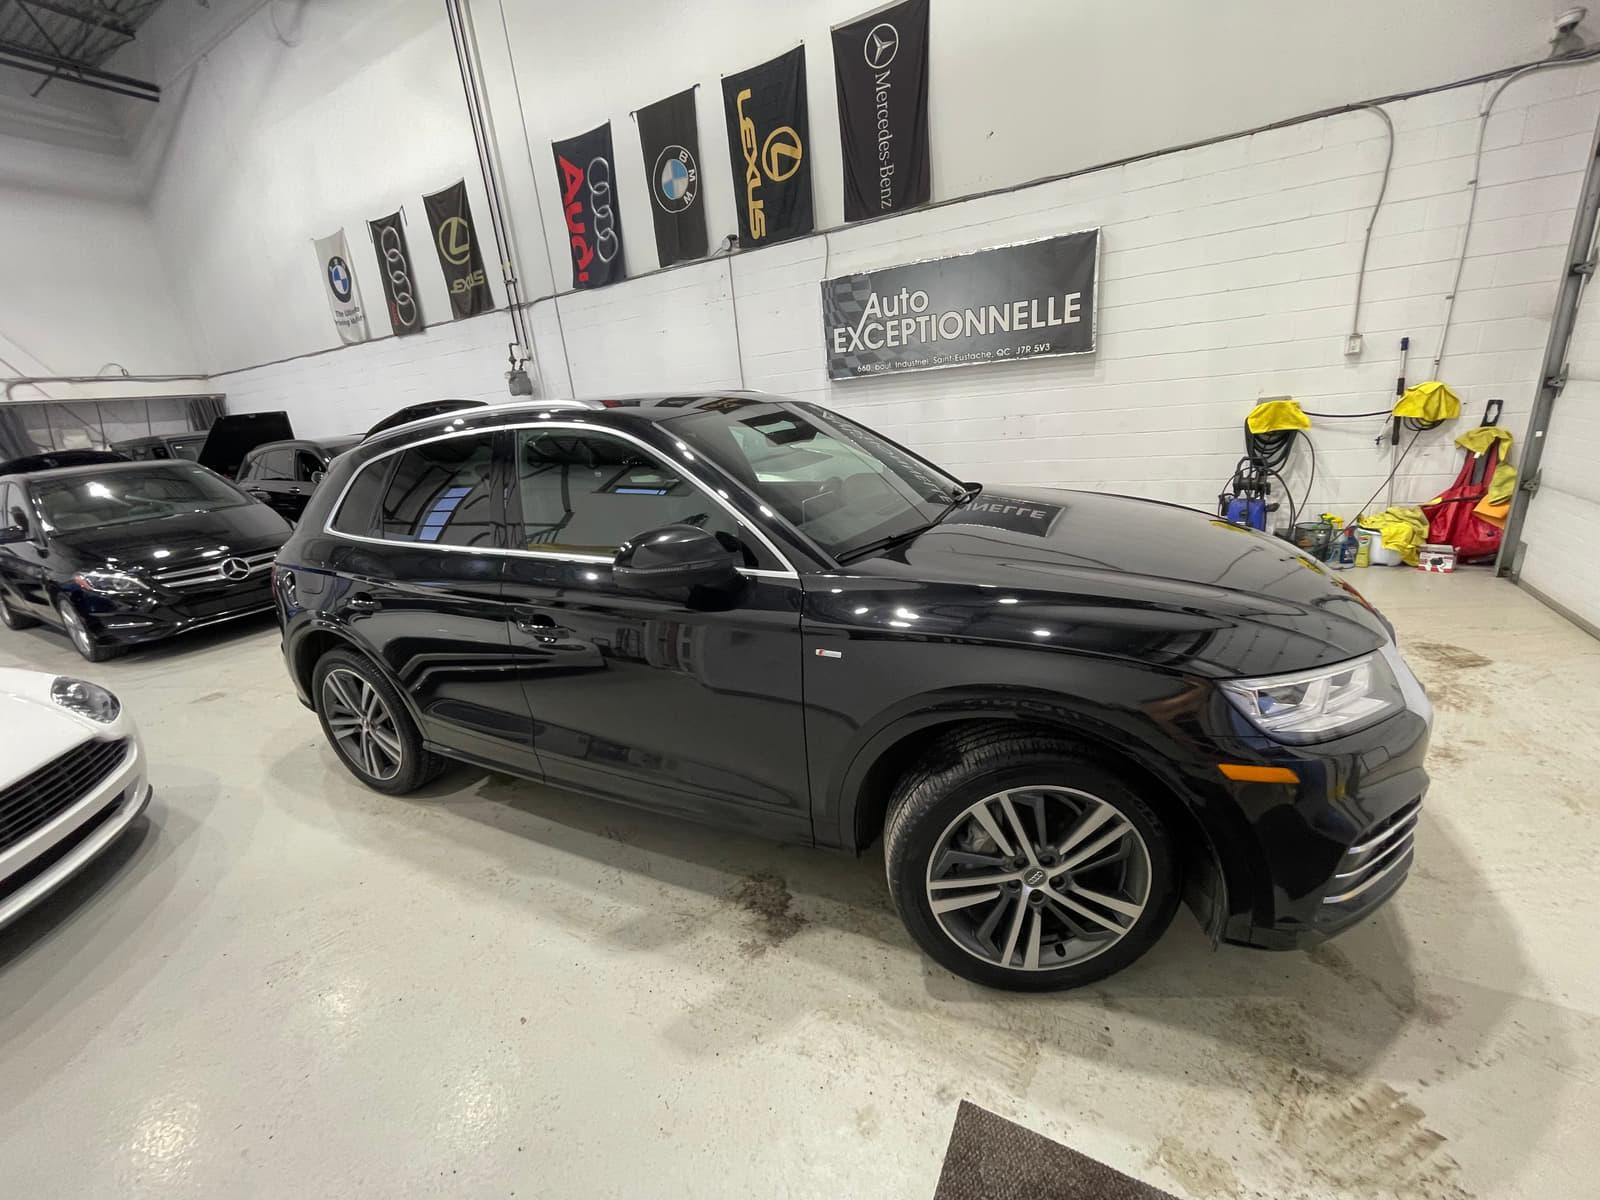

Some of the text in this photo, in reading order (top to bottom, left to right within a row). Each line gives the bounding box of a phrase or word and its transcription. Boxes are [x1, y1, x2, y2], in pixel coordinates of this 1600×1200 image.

[736, 88, 767, 240] LEXUS
[874, 69, 895, 209] Mercedes-Benz
[833, 292, 1081, 353] EXCEPTIONNELLE
[864, 287, 929, 322] Auto
[996, 342, 1011, 357] QC
[1016, 340, 1032, 355] J7R
[1034, 338, 1051, 352] 5V3
